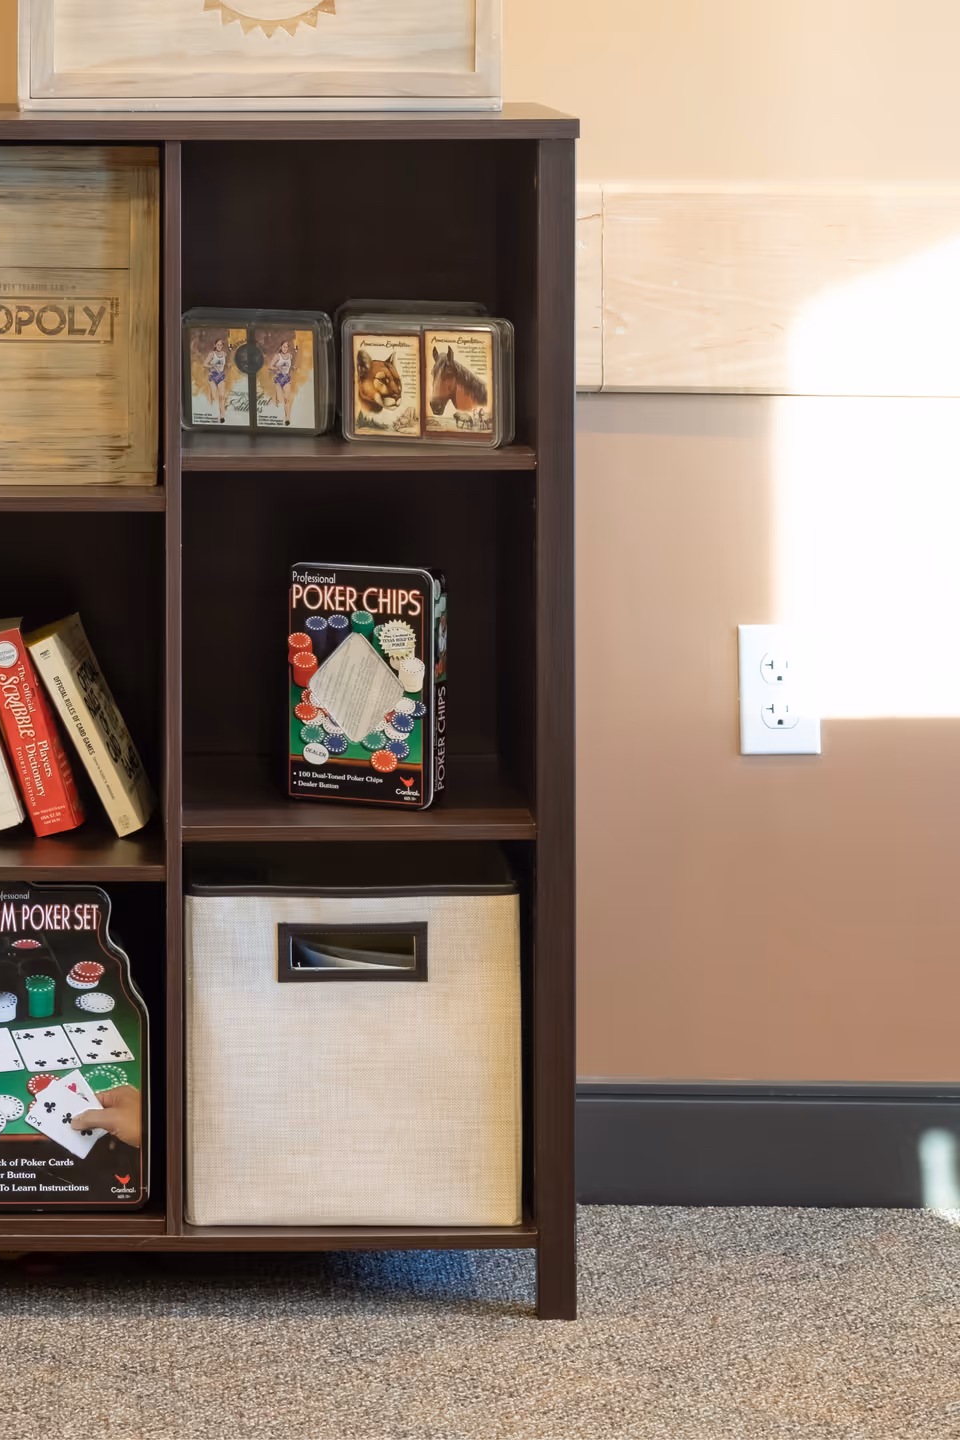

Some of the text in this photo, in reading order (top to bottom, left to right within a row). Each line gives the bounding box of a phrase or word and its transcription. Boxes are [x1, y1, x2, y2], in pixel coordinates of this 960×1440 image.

[292, 571, 336, 584] Professional
[292, 583, 421, 616] POKER CHIPS
[22, 683, 36, 713] Official
[53, 676, 96, 756] OFFICIAL RULES OF CARD GAMES
[437, 686, 446, 791] POKER CHIPS
[37, 740, 52, 777] Players
[305, 746, 327, 759] DEALER
[16, 746, 36, 807] FOURTH EDITION
[25, 743, 45, 797] Dictionary
[312, 772, 346, 781] Dual-Toned
[346, 774, 365, 782] Poker
[365, 776, 384, 784] Chips
[298, 780, 339, 790] Dealer Button
[21, 903, 70, 930] POKER
[73, 904, 99, 930] SET
[7, 1171, 36, 1179] Button
[9, 1158, 18, 1167] of
[20, 1158, 46, 1167] Poker
[48, 1158, 74, 1167] Cards
[12, 1184, 37, 1192] Learn
[39, 1183, 89, 1192] Instructions
